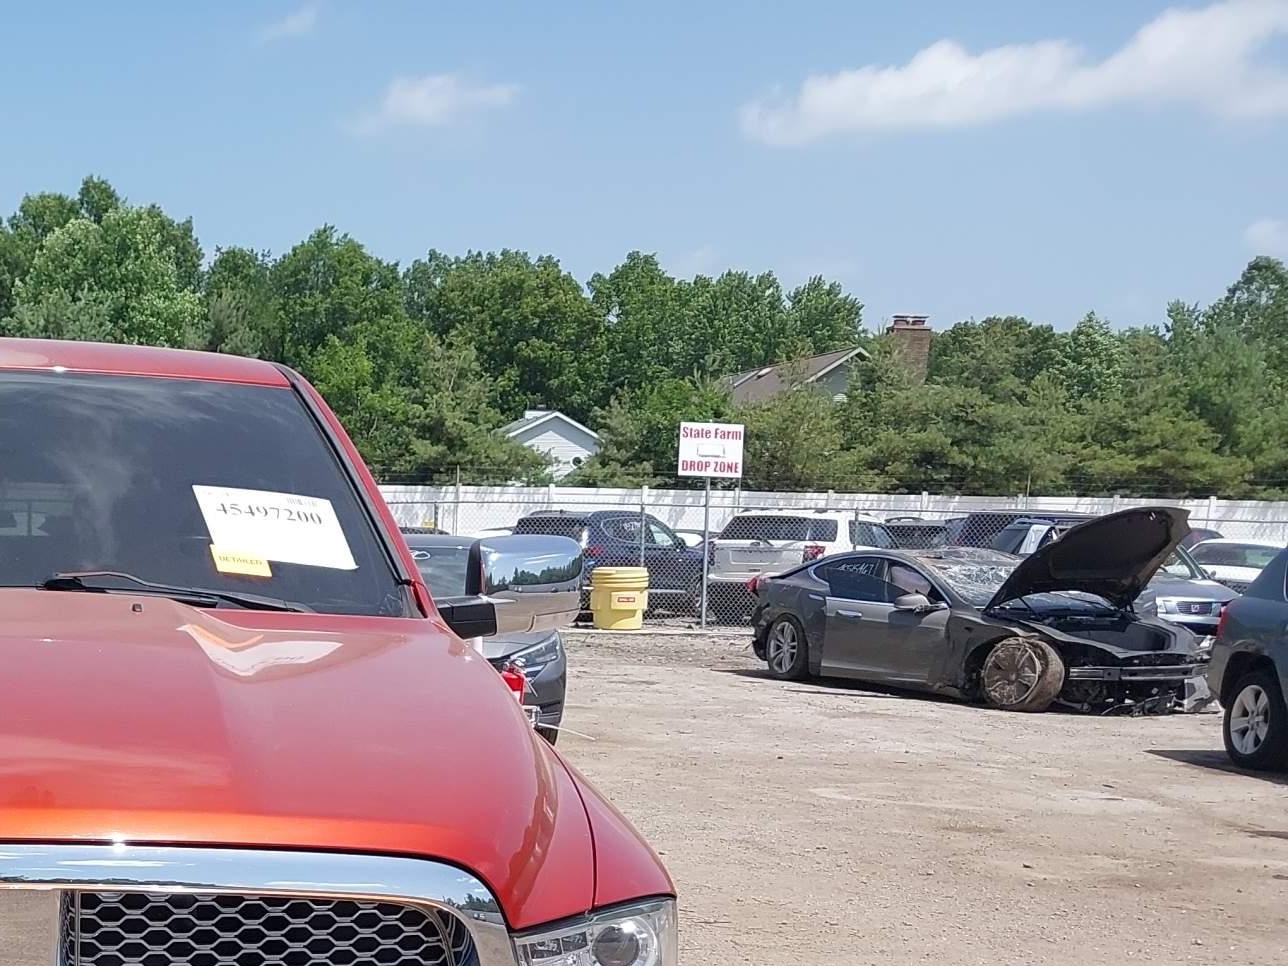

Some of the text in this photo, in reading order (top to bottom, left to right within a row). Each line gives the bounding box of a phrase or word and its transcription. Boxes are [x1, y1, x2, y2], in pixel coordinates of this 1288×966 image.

[682, 426, 742, 441] State Farm
[681, 459, 739, 474] DROP ZONE
[216, 502, 323, 525] 45497200
